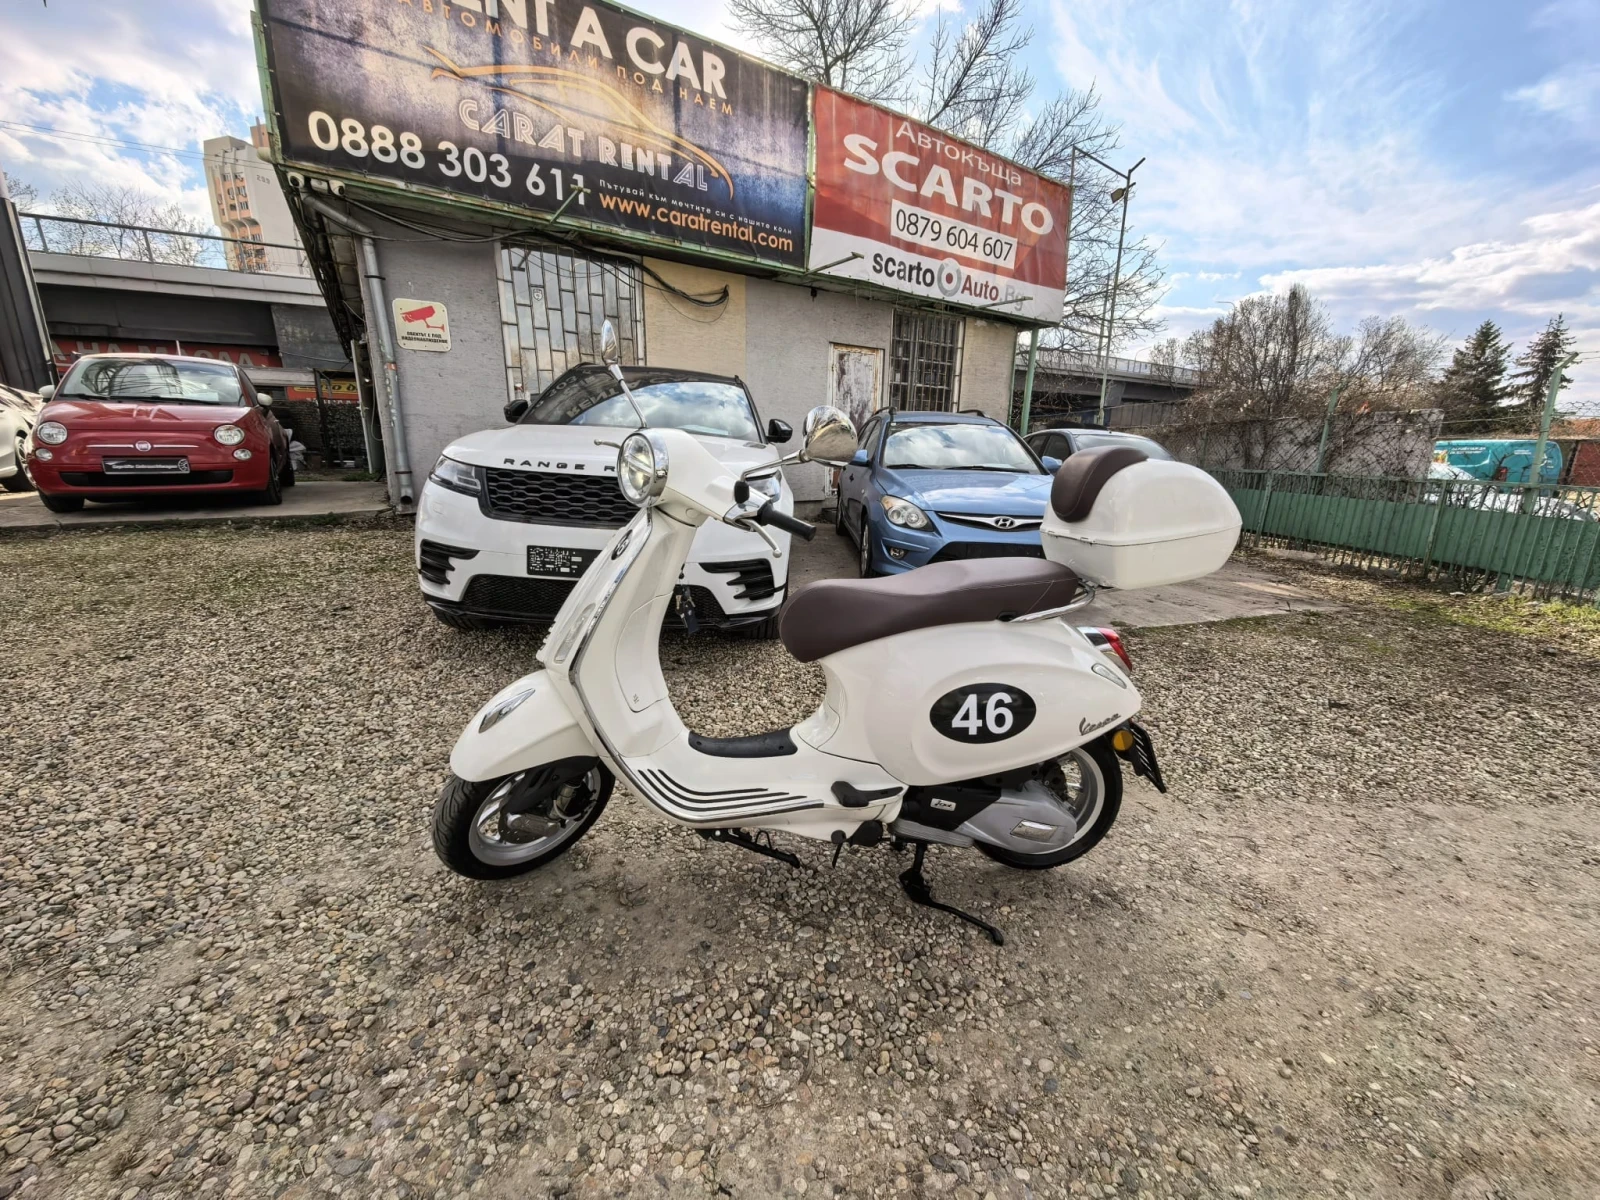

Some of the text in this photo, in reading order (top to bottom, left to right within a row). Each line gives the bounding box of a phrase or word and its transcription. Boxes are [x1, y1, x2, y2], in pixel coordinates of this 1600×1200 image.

[570, 6, 613, 59] A
[626, 27, 727, 99] CAR
[616, 66, 663, 94] ПОД
[679, 88, 733, 115] НАЕМ
[308, 111, 585, 206] 0888 303 611
[459, 99, 709, 191] CARAT RENTAL
[896, 121, 1023, 187] Автокъща
[599, 179, 645, 197] Пътувай
[648, 193, 667, 203] към
[671, 199, 711, 214] мечтите
[715, 210, 726, 218] си
[738, 216, 770, 229] нашите
[773, 225, 792, 234] коли
[843, 133, 1054, 235] SCARTO
[599, 192, 793, 252] www.caratrental.com
[895, 208, 1014, 262] 0879 604 607
[872, 252, 935, 288] scarto
[503, 458, 585, 470] RANGE
[951, 692, 1014, 736] 46
